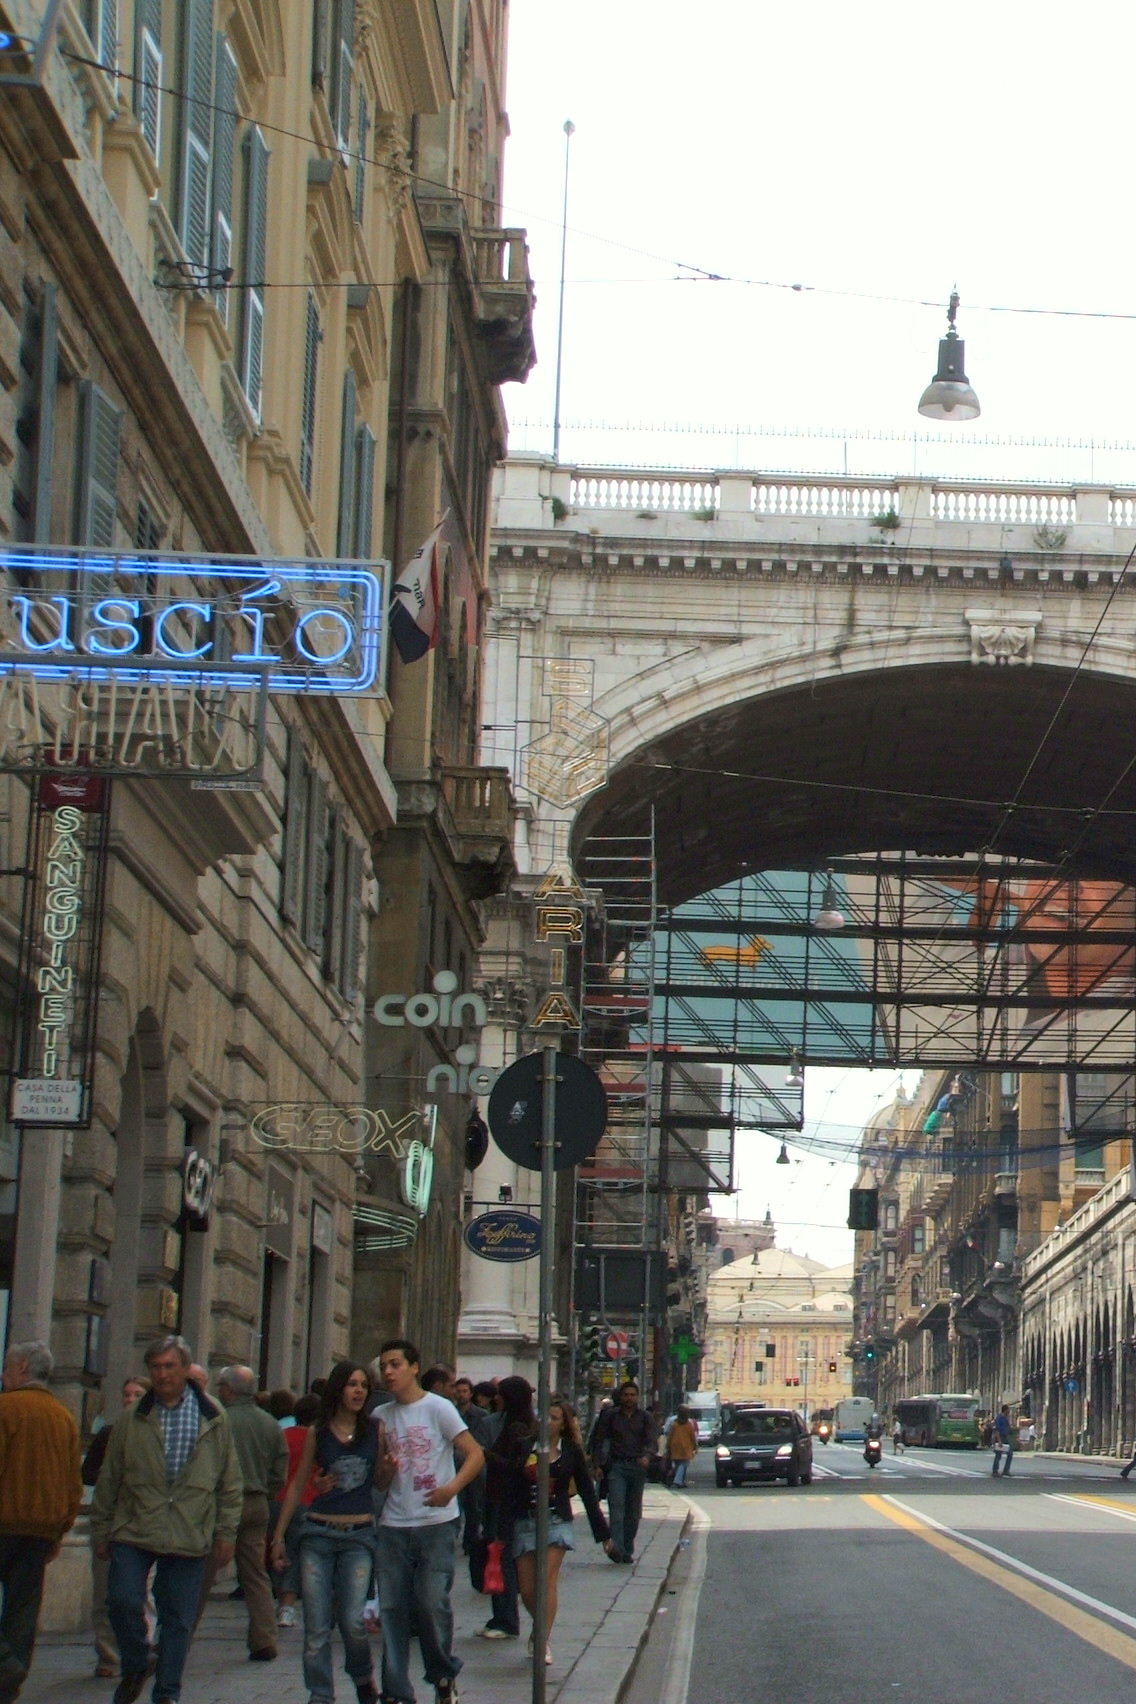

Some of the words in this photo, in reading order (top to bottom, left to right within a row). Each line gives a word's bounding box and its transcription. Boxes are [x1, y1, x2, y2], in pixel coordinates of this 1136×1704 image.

[38, 806, 85, 1077] SANGUINETI
[374, 970, 487, 1028] coin
[16, 1083, 44, 1092] CASA
[47, 1084, 78, 1093] DELLA
[30, 1094, 64, 1104] PENNA
[22, 1105, 40, 1114] DAL
[251, 1104, 422, 1158] GEOX
